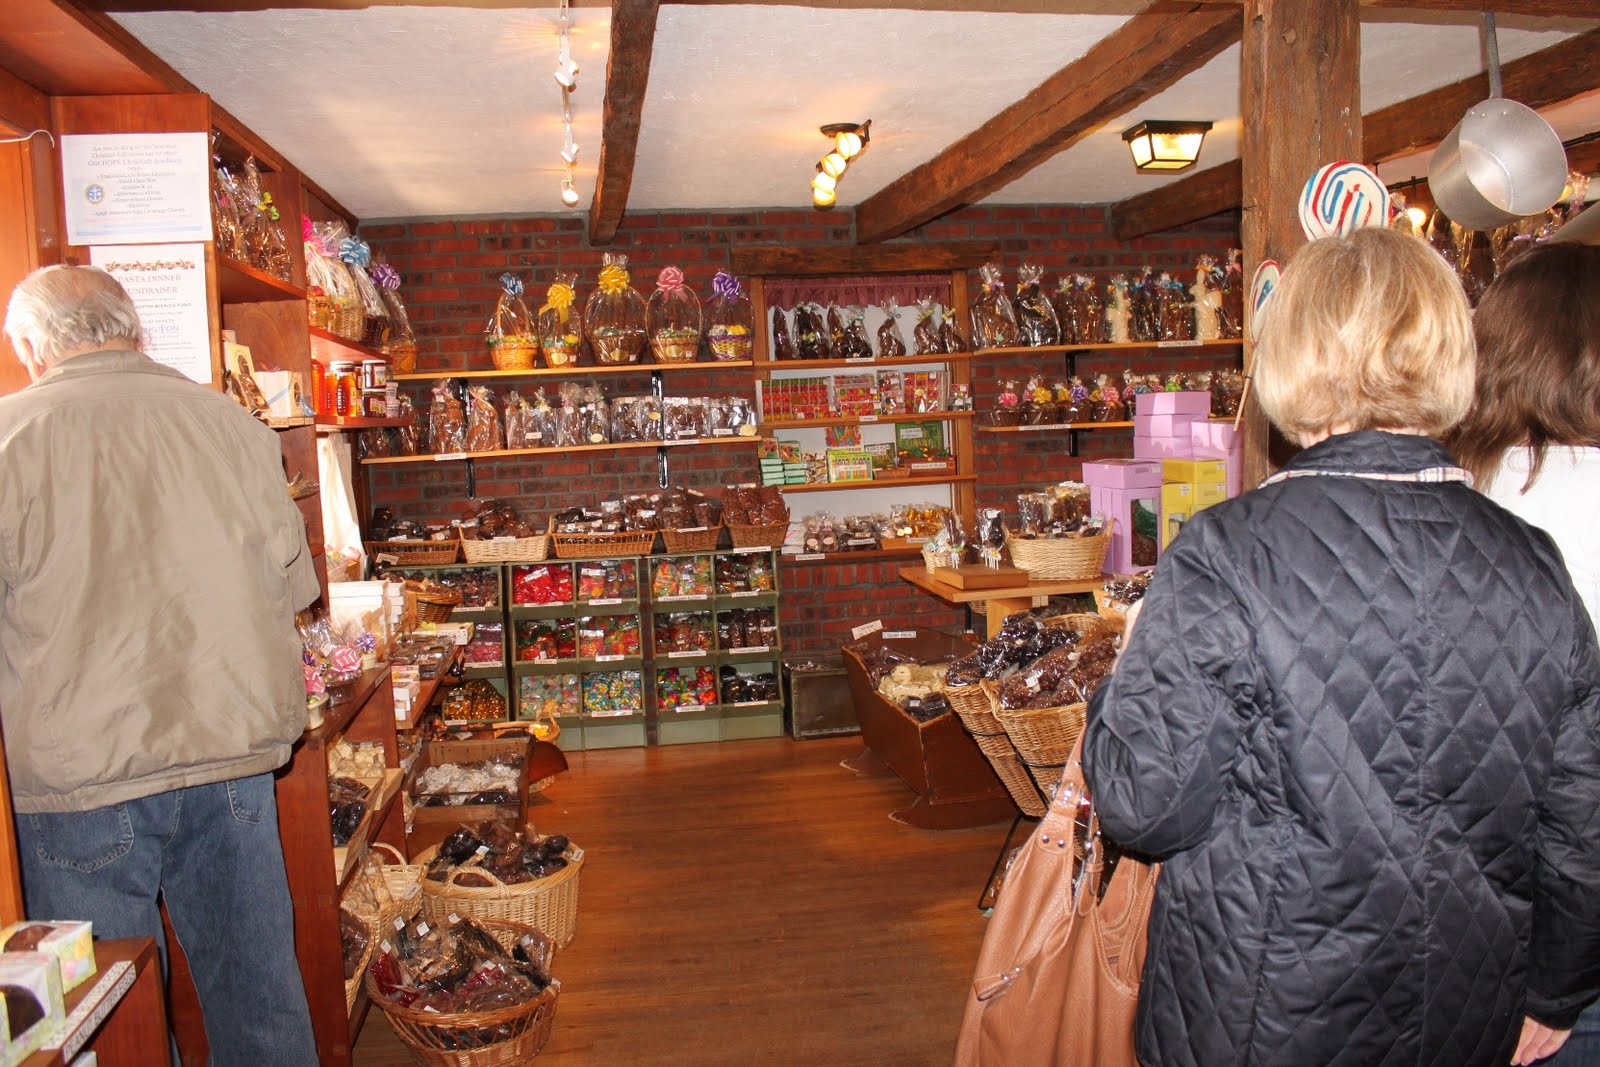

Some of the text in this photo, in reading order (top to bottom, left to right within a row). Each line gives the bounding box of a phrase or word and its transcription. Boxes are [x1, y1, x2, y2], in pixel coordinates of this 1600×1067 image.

[118, 274, 182, 283] PASTA DINNER
[126, 286, 178, 295] UNDRAISER
